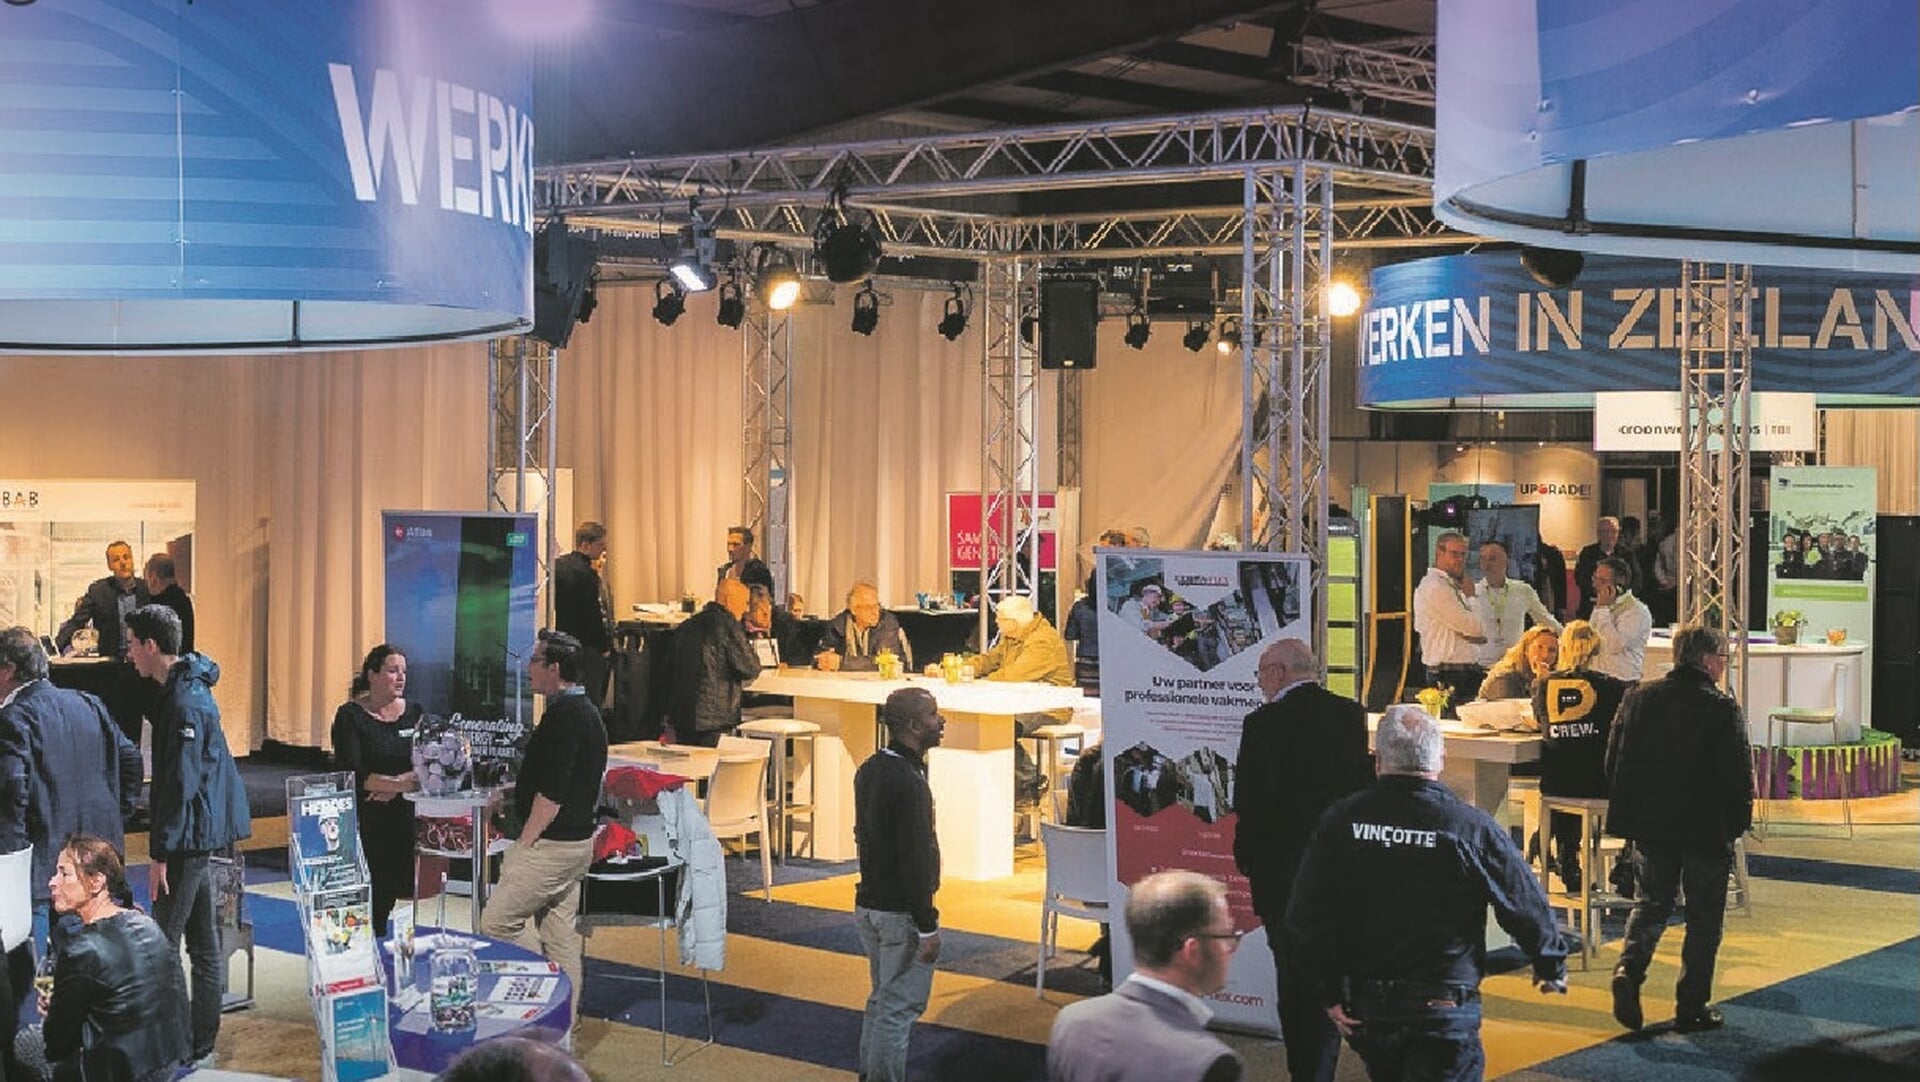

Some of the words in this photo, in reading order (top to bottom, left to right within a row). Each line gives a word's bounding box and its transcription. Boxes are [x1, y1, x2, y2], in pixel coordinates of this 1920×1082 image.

[328, 62, 535, 238] WERK
[1515, 289, 1583, 352] IN
[1520, 483, 1591, 496] UPGRADE!
[1152, 676, 1175, 687] Uw
[1176, 679, 1226, 691] partner
[1124, 690, 1210, 706] professionele
[1352, 822, 1437, 848] VINÇOTTE
